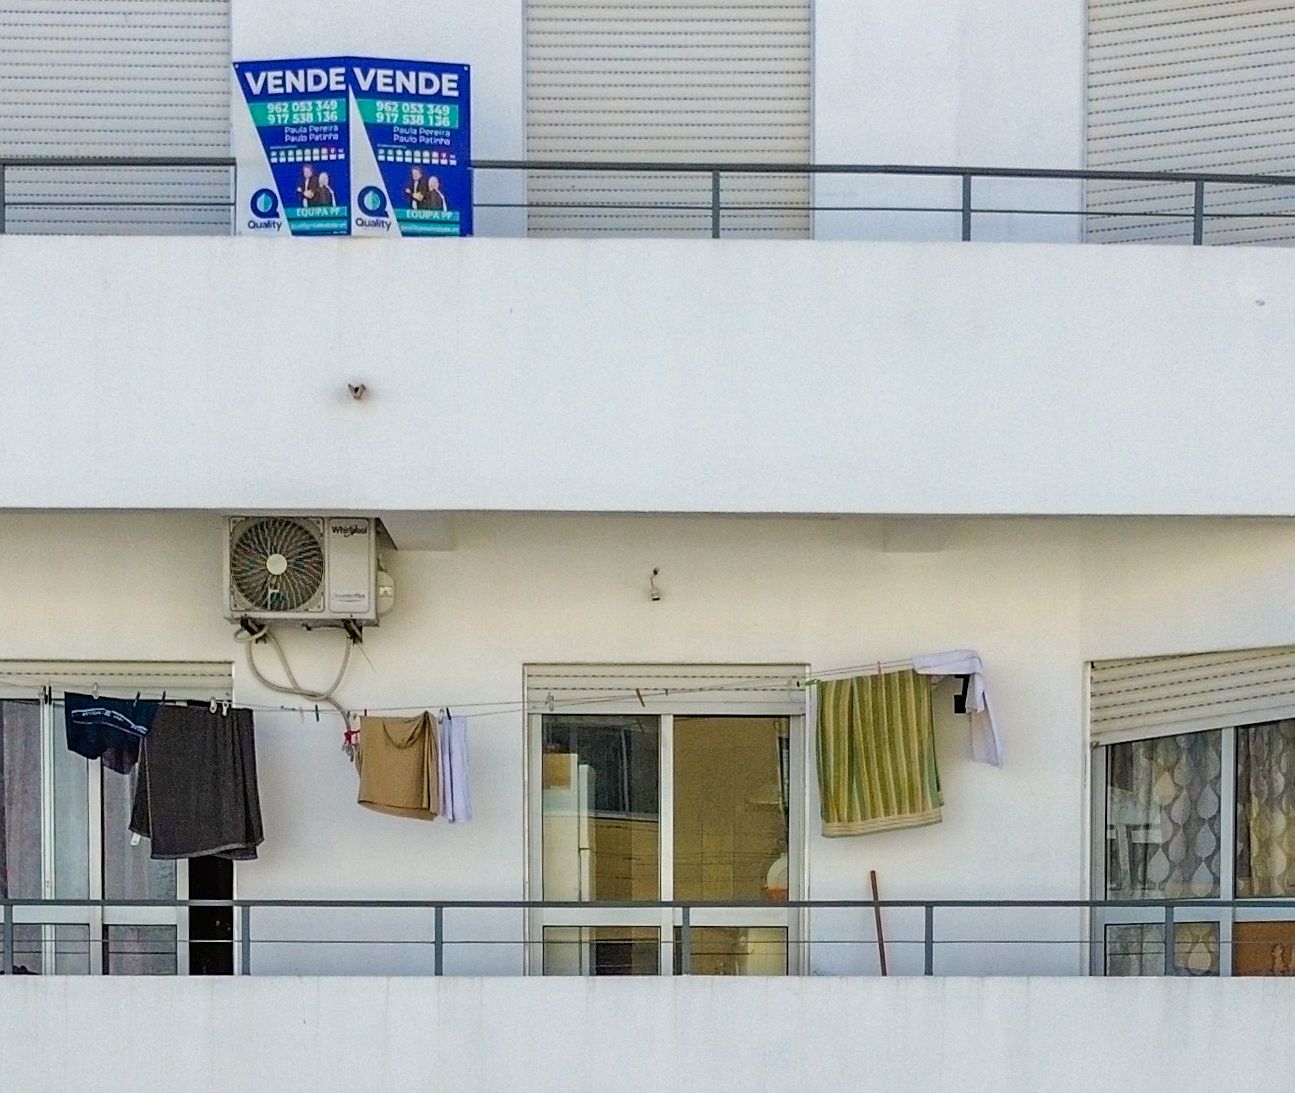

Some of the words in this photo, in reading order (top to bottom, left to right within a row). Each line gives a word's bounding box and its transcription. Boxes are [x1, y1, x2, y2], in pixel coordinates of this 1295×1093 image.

[245, 67, 346, 95] VENDE
[353, 67, 459, 97] VENDE
[267, 103, 289, 113] 962
[376, 101, 398, 112] 962
[268, 114, 289, 124] 917
[293, 113, 313, 124] 538
[319, 111, 338, 122] 136
[376, 112, 397, 123] 917
[429, 116, 450, 127] 136
[285, 126, 307, 134] Paula
[309, 125, 338, 133] Pereira
[393, 127, 417, 135] Paula
[419, 129, 450, 137] Pereira
[285, 135, 307, 143] Paulo
[309, 133, 338, 141] Patinha
[393, 135, 417, 144] Paulo
[419, 137, 450, 145] Patinha
[297, 207, 327, 217] EQUIPA
[248, 220, 282, 231] Quality
[356, 218, 391, 231] Quality
